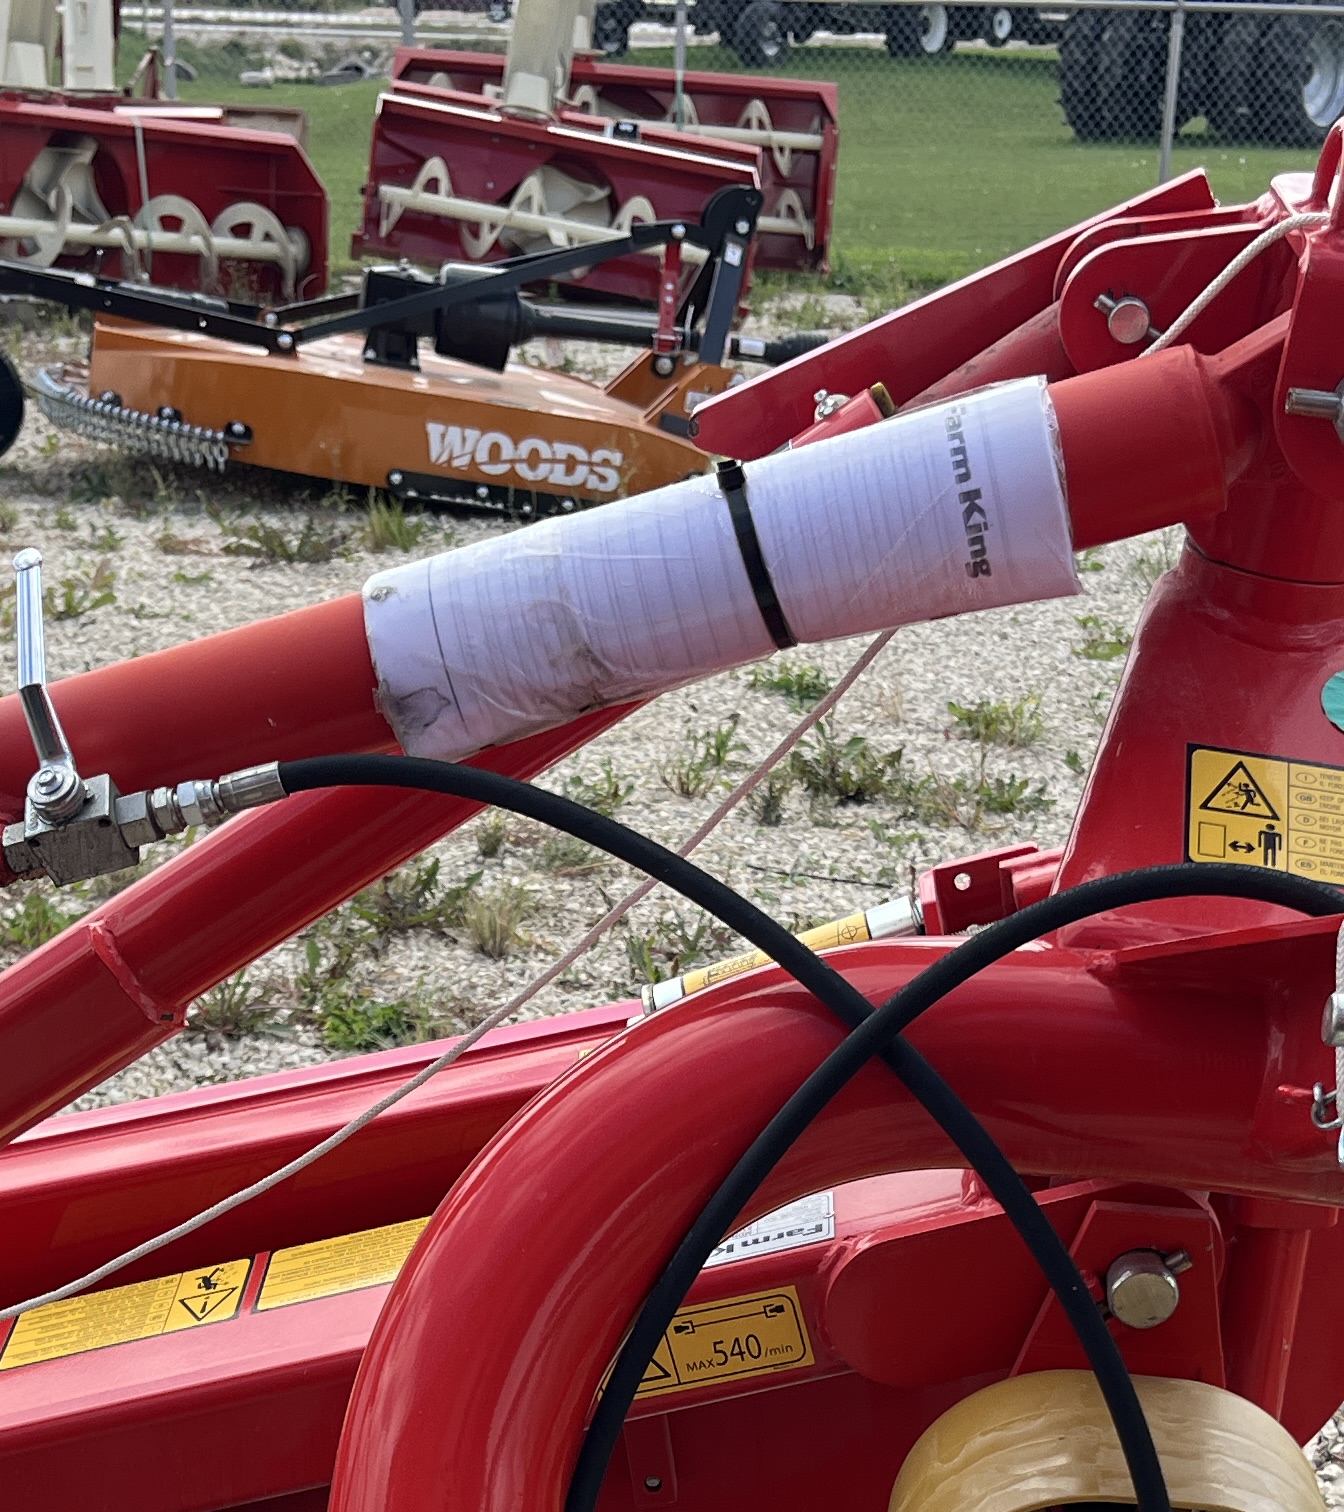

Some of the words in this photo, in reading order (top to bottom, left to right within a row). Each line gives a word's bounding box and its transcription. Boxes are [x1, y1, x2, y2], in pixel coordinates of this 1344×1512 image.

[426, 421, 623, 492] WOODS
[958, 487, 992, 578] King
[741, 1224, 823, 1248] Farm
[686, 1358, 714, 1373] MAX
[713, 1333, 762, 1367] 540
